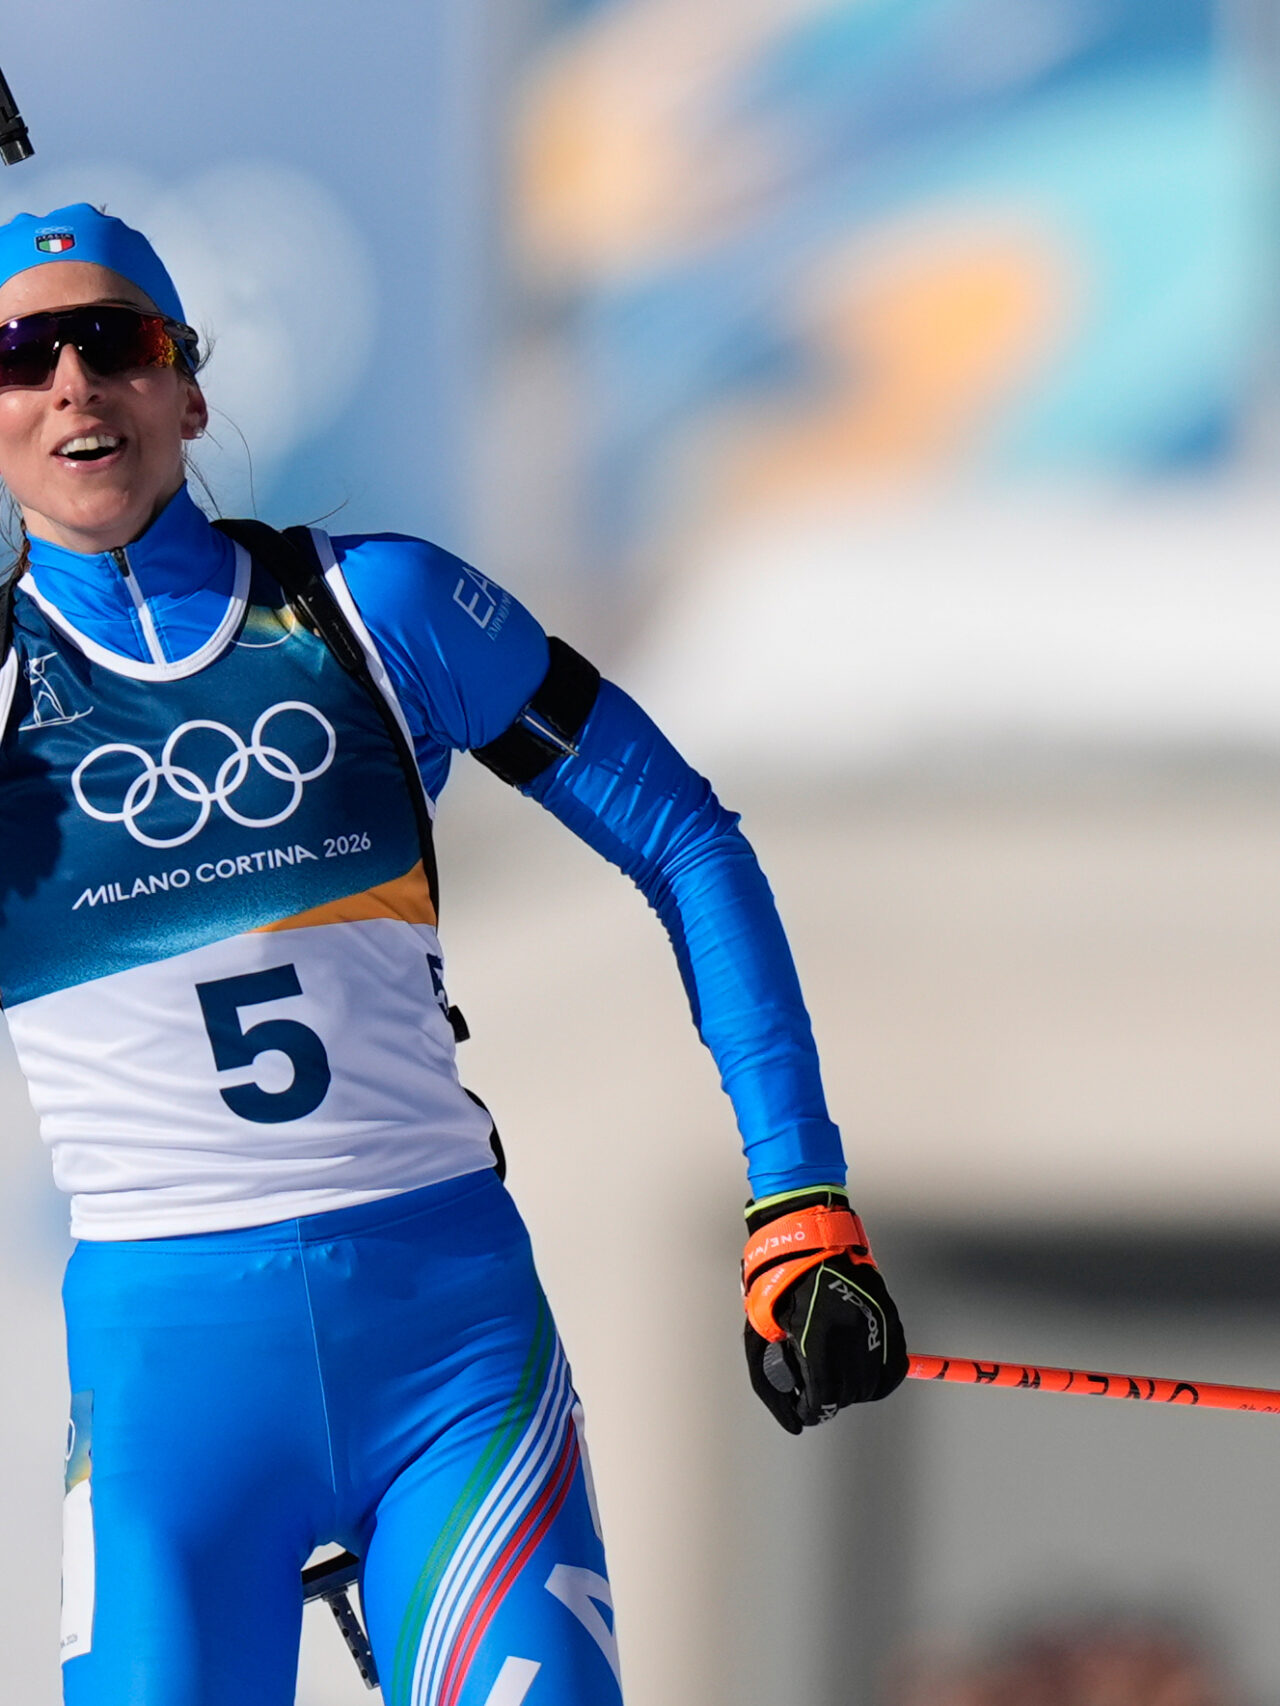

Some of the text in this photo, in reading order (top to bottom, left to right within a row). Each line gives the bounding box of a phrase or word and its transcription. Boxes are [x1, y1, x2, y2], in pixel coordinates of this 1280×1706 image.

[72, 832, 372, 911] MILANO CORTINA 2026
[195, 963, 331, 1124] 5
